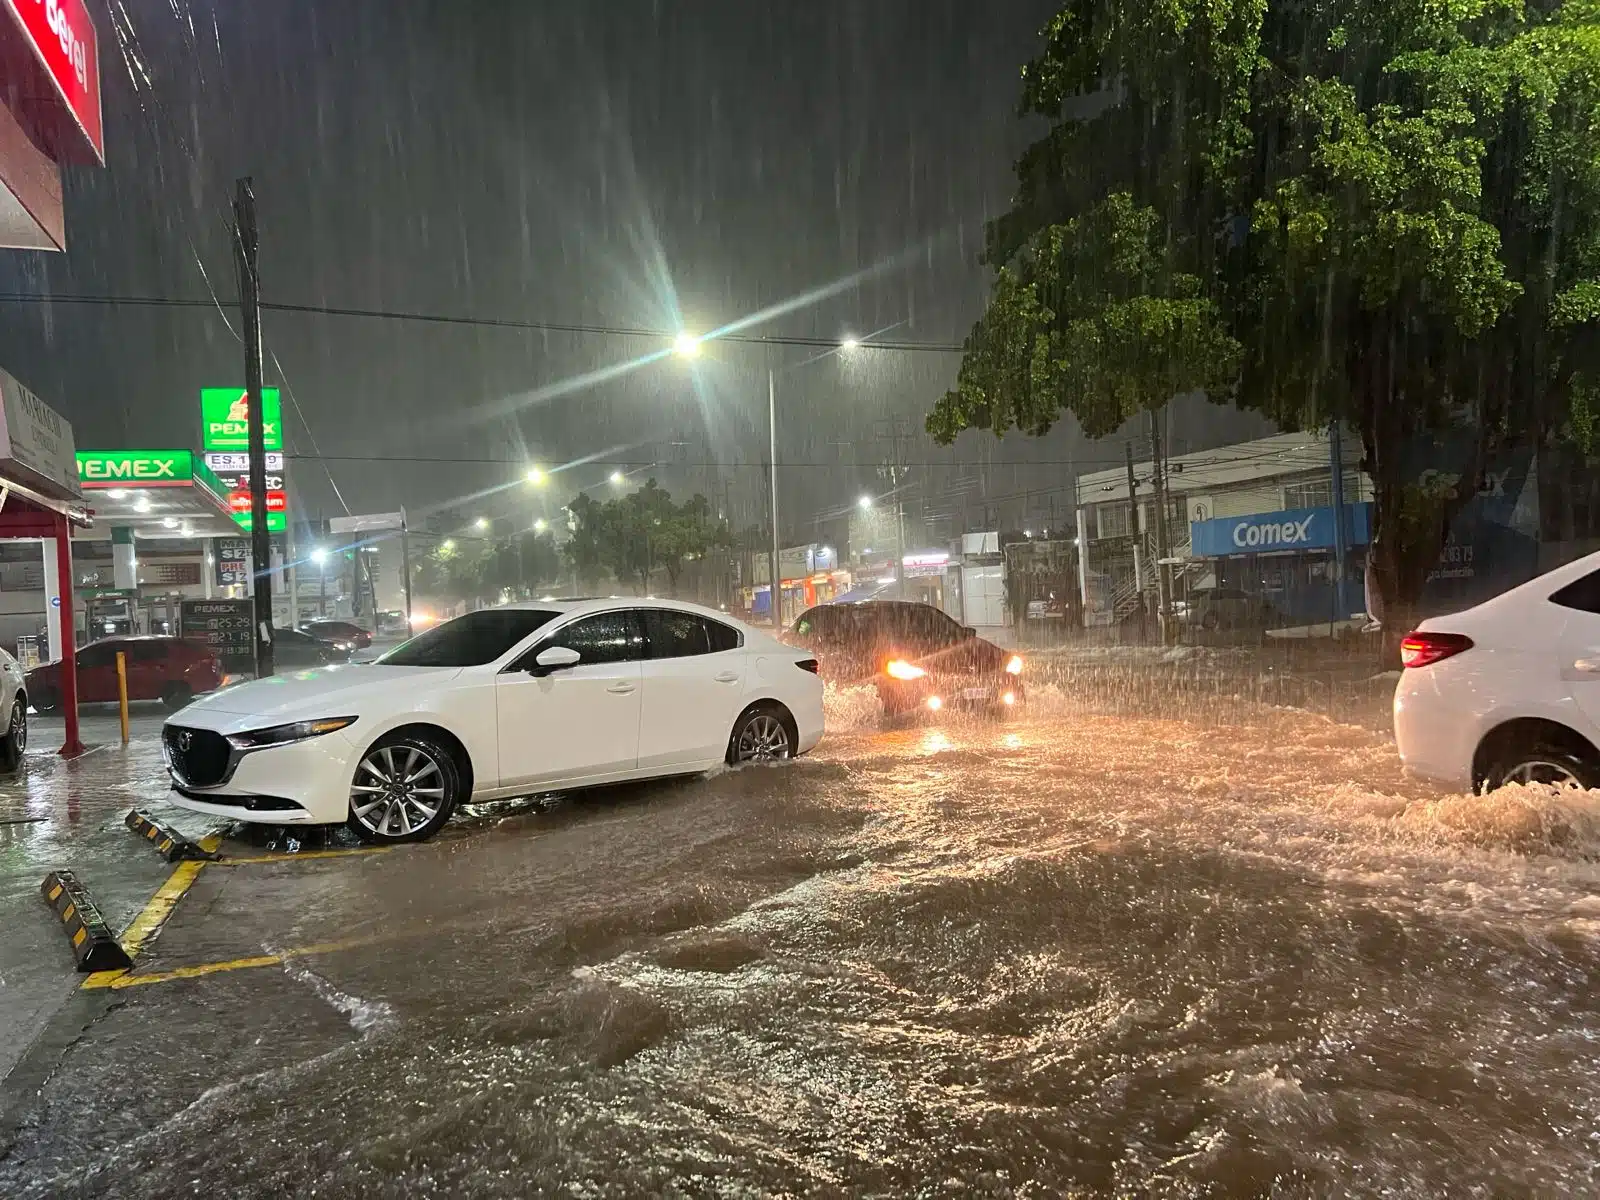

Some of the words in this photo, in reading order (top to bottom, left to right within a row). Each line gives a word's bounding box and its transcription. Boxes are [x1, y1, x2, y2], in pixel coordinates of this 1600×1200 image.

[209, 423, 276, 435] PEMX
[1233, 513, 1315, 547] Comex
[194, 605, 235, 613] PEMEX
